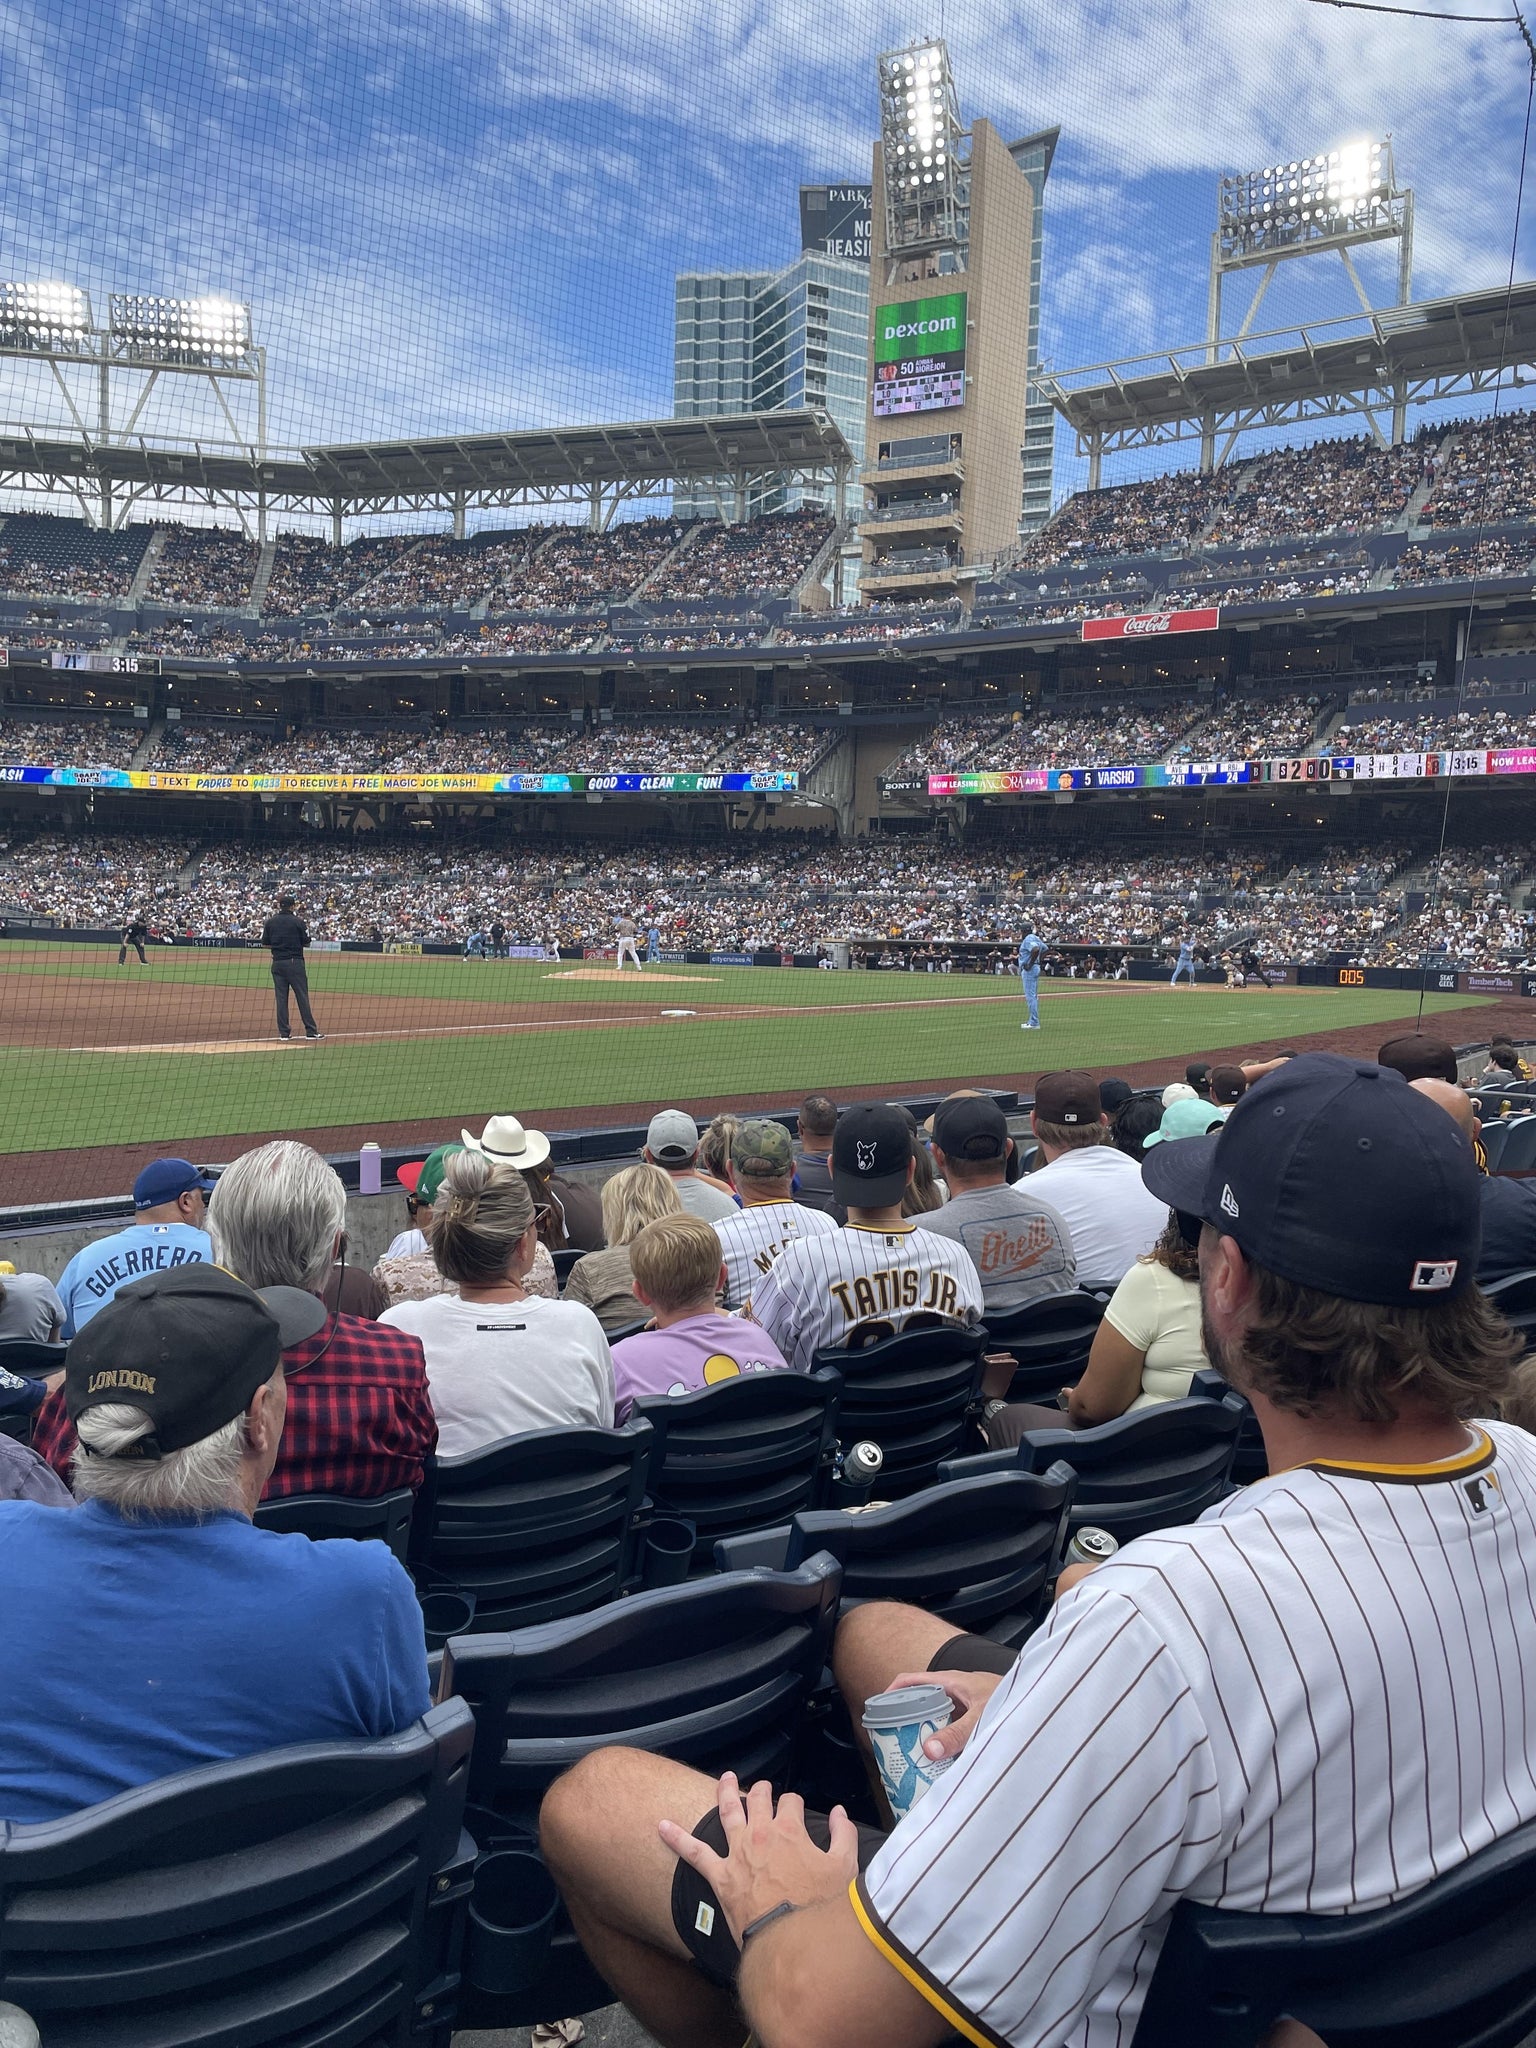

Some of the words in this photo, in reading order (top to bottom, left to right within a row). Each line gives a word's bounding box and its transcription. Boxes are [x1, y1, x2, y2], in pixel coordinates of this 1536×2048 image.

[829, 189, 865, 201] PARK
[900, 361, 914, 375] 50
[915, 361, 946, 373] MOREJON
[112, 658, 139, 673] 3:15
[1369, 757, 1374, 766] 3
[1392, 755, 1398, 765] 8
[1454, 757, 1478, 770] 3:15
[1491, 757, 1514, 766] NOW
[1280, 765, 1286, 776] S
[1291, 760, 1301, 779] 2
[1355, 763, 1361, 773] R
[1379, 762, 1385, 772] H
[1403, 761, 1409, 771] E
[1369, 768, 1374, 778] 3
[1392, 767, 1398, 776] 4
[1416, 766, 1422, 775] 0
[162, 777, 190, 786] TEXT
[196, 778, 232, 788] PADRES
[236, 778, 249, 787] TO
[253, 778, 280, 788] 94333
[285, 778, 297, 787] TO
[300, 778, 338, 787] RECEIVE
[341, 778, 348, 787] A
[352, 778, 380, 788] FREE
[383, 778, 417, 788] MAGIC
[420, 778, 439, 787] JOE
[441, 778, 477, 787] WASH!
[588, 776, 618, 789] GOOD
[639, 776, 675, 789] CLEAN
[696, 776, 723, 789] FUN!
[751, 774, 779, 783] SOAPY
[932, 781, 949, 789] NOW
[949, 780, 978, 788] LEASING
[980, 776, 1024, 789] ANCORA
[1084, 772, 1091, 786] 5
[1098, 770, 1134, 785] VARSHO
[1168, 775, 1185, 785] .241
[1201, 773, 1206, 784] 7
[1226, 772, 1238, 783] 24
[885, 782, 912, 790] SONY
[1468, 976, 1513, 987] TimberTech
[85, 1245, 202, 1298] GUERRERO
[831, 1269, 919, 1320] TATIS
[923, 1271, 965, 1318] JR.
[87, 1369, 157, 1395] LONDON
